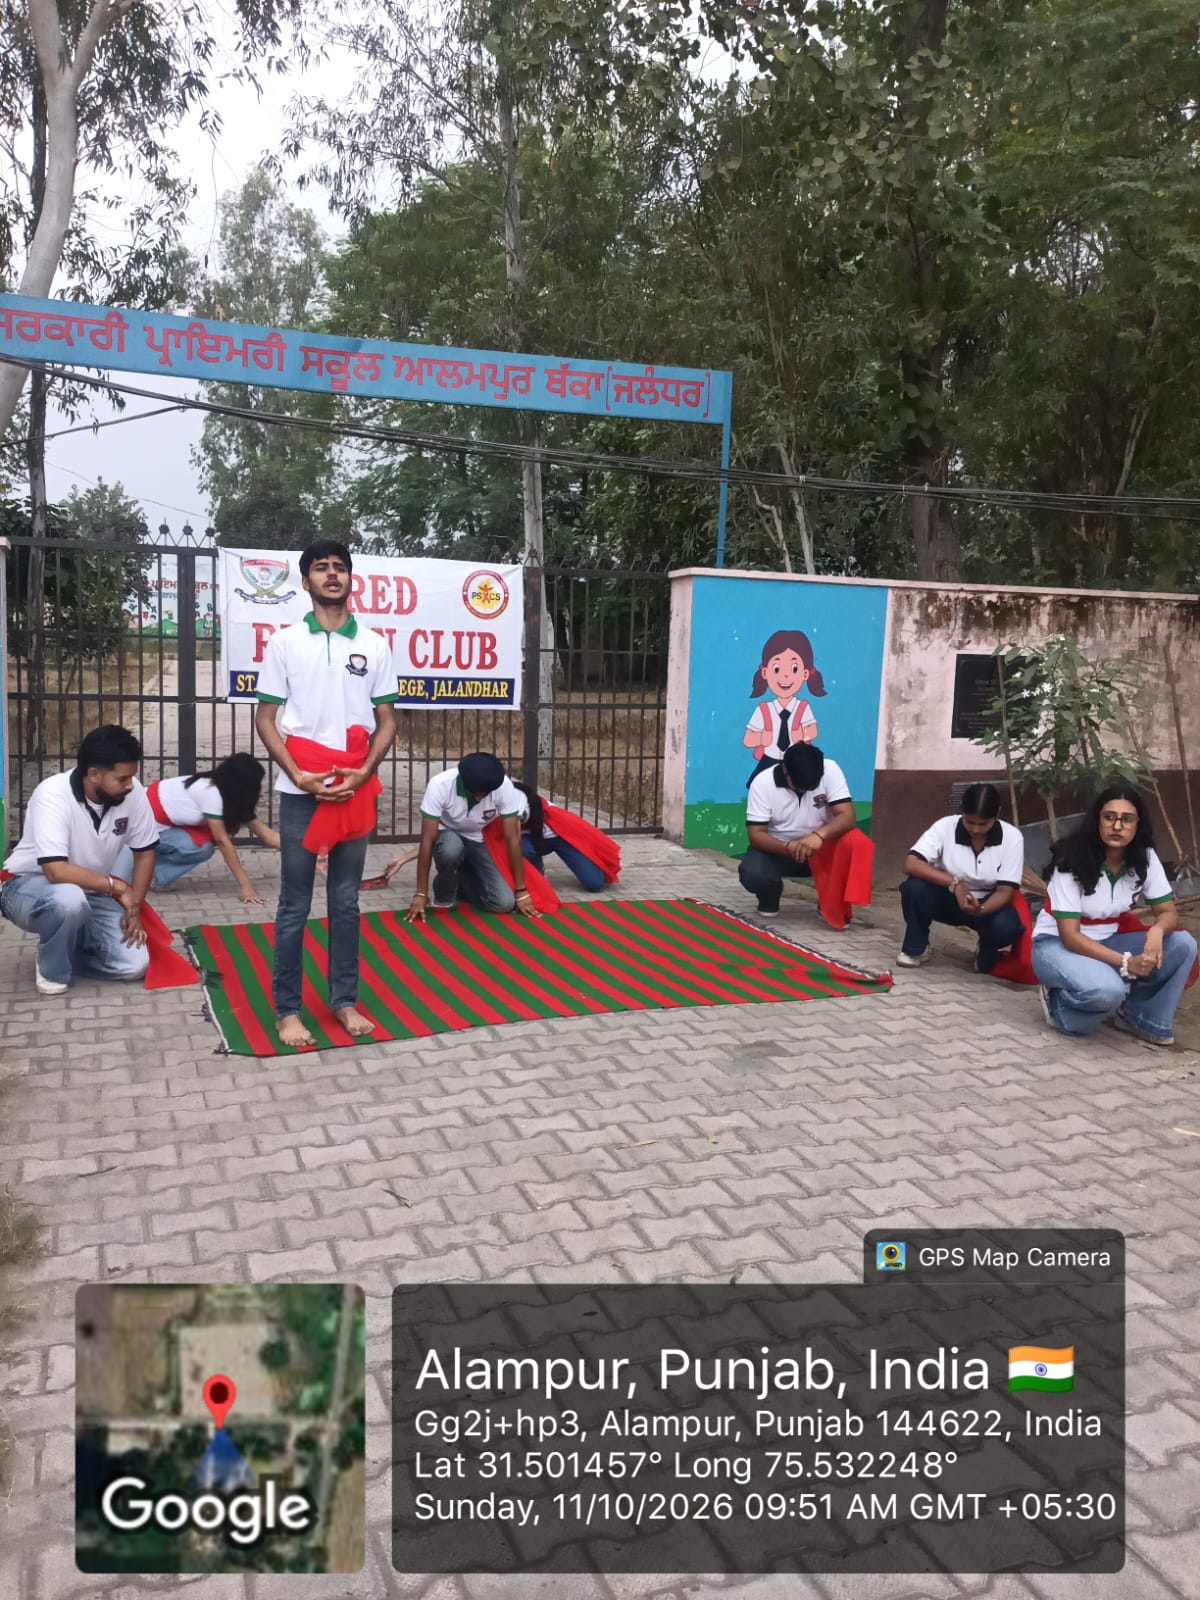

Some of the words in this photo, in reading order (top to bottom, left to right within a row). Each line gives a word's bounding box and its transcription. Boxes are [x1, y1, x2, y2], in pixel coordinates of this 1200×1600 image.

[143, 322, 288, 371] ਪ੍ਰਾਇਮਰੀ
[299, 345, 385, 391] ਸਕੂਲ
[392, 356, 536, 400] ਆਲਮਪੁਰ
[544, 361, 604, 399] ਬੱਕਾ
[346, 574, 418, 615] RED
[408, 629, 498, 671] CLUB
[431, 679, 509, 701] JALANDHAR
